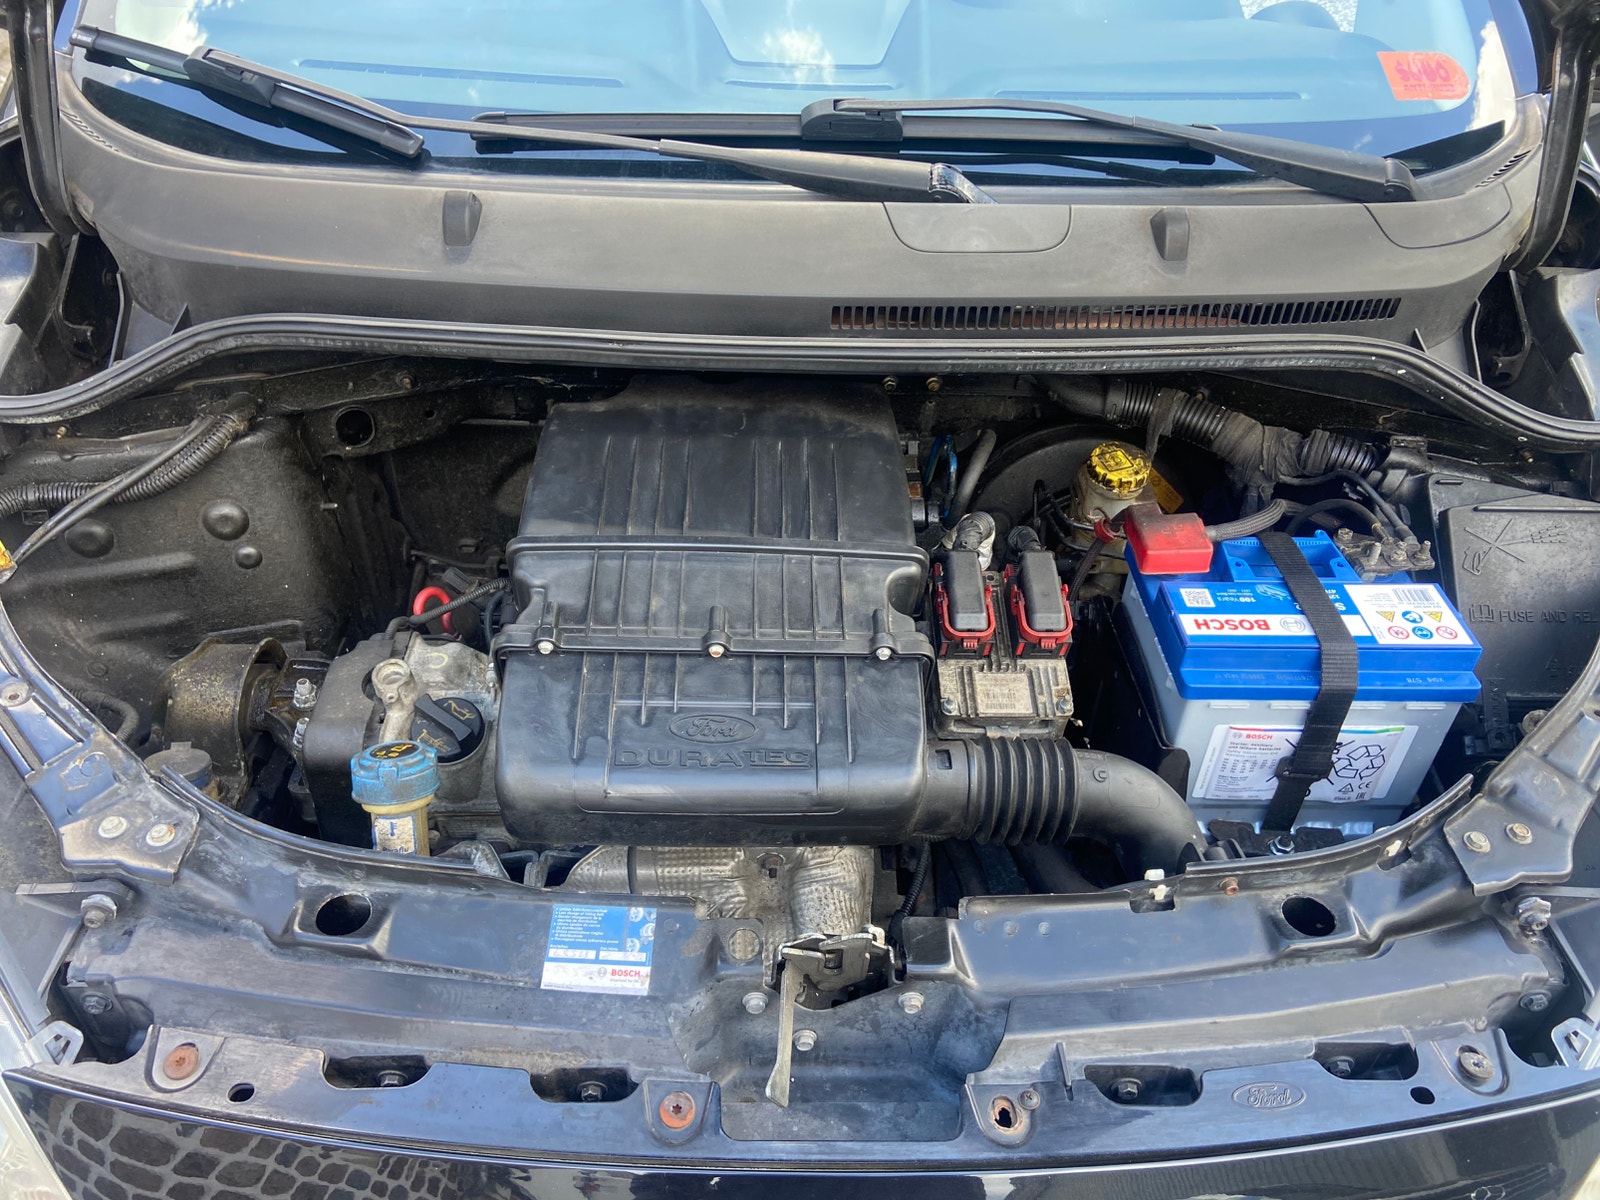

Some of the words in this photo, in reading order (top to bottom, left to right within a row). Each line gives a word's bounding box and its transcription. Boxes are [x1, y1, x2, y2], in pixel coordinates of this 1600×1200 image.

[1499, 609, 1535, 623] FUSE
[1540, 609, 1567, 623] AND
[1193, 618, 1271, 631] BOSCH
[685, 717, 741, 738] Ford
[1245, 733, 1273, 741] BOSCH
[613, 749, 813, 768] DURATEC
[611, 968, 641, 978] BOSCH
[1247, 1084, 1292, 1108] Ford
